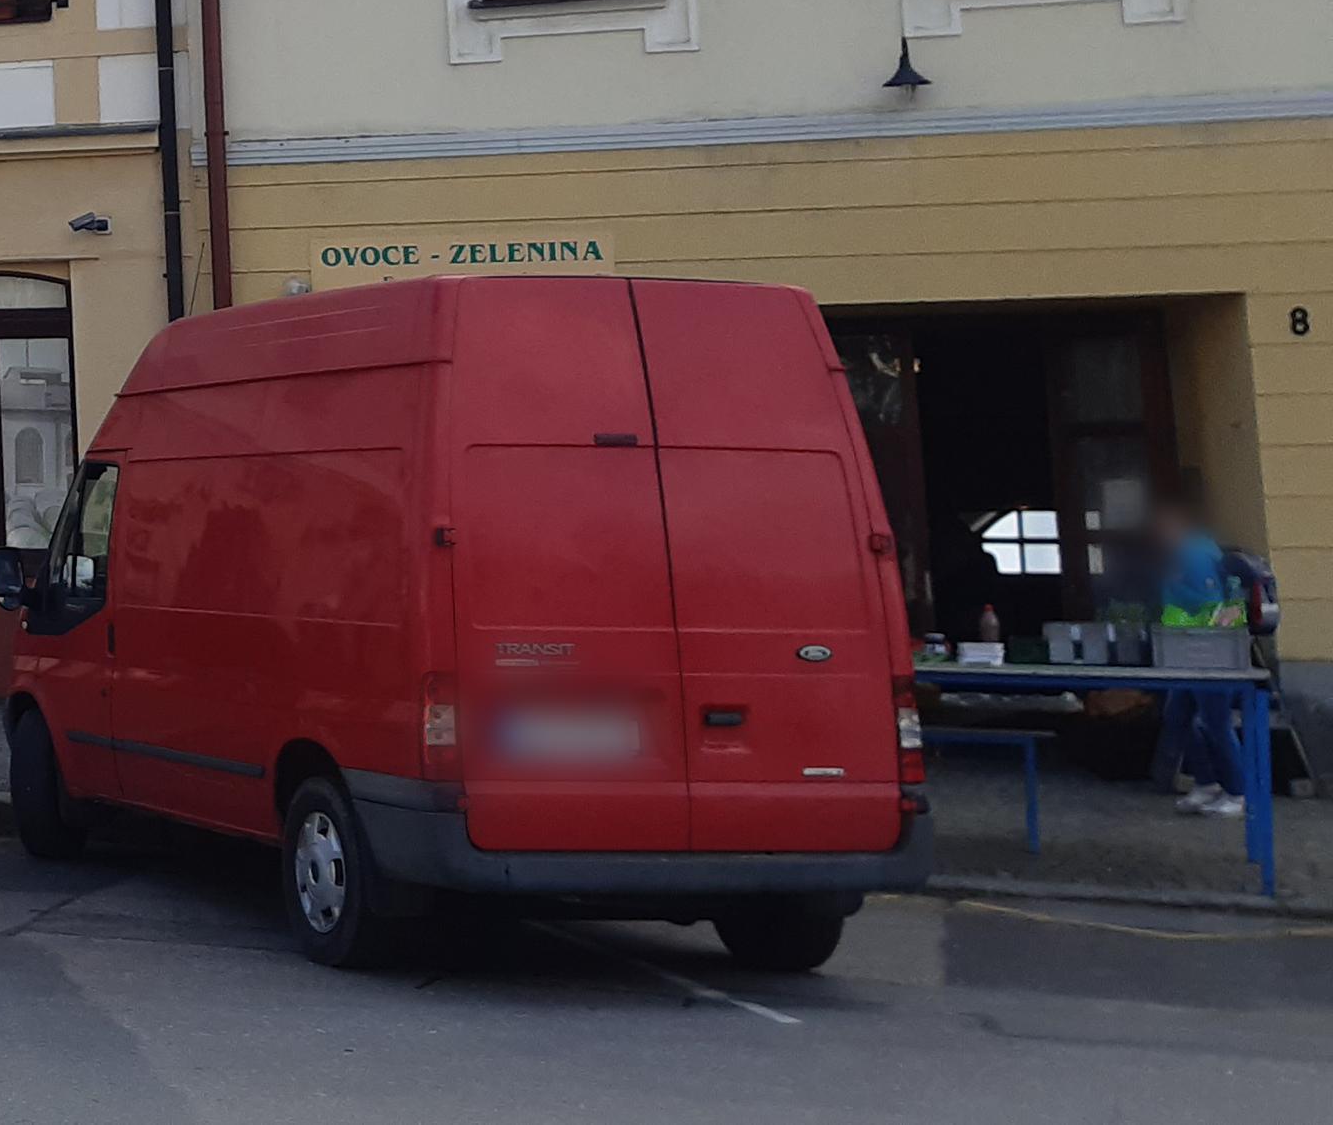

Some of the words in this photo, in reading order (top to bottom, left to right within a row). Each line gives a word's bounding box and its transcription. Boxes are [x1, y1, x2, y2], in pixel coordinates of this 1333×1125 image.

[320, 245, 420, 267] OVOCE
[449, 240, 604, 265] ZELENINA
[1290, 307, 1309, 335] 8
[496, 643, 575, 655] TRANSIT
